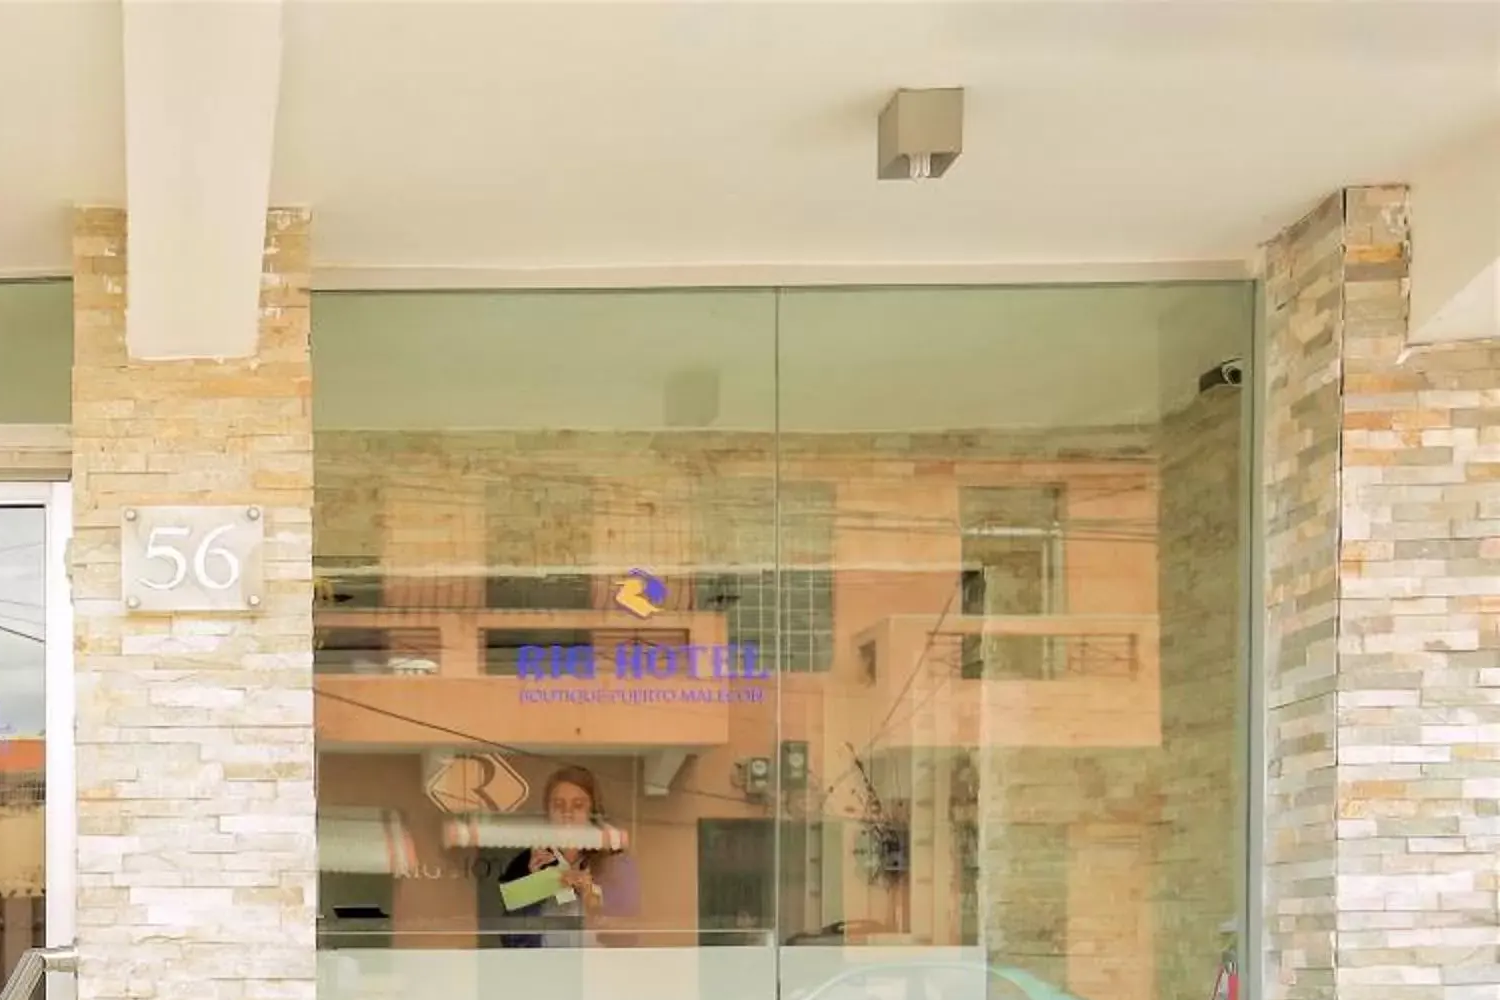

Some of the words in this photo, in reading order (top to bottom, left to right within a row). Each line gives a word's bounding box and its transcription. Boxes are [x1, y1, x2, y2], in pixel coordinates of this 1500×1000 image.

[137, 522, 237, 591] 56
[516, 641, 595, 680] RIG
[614, 639, 770, 680] HOTEL
